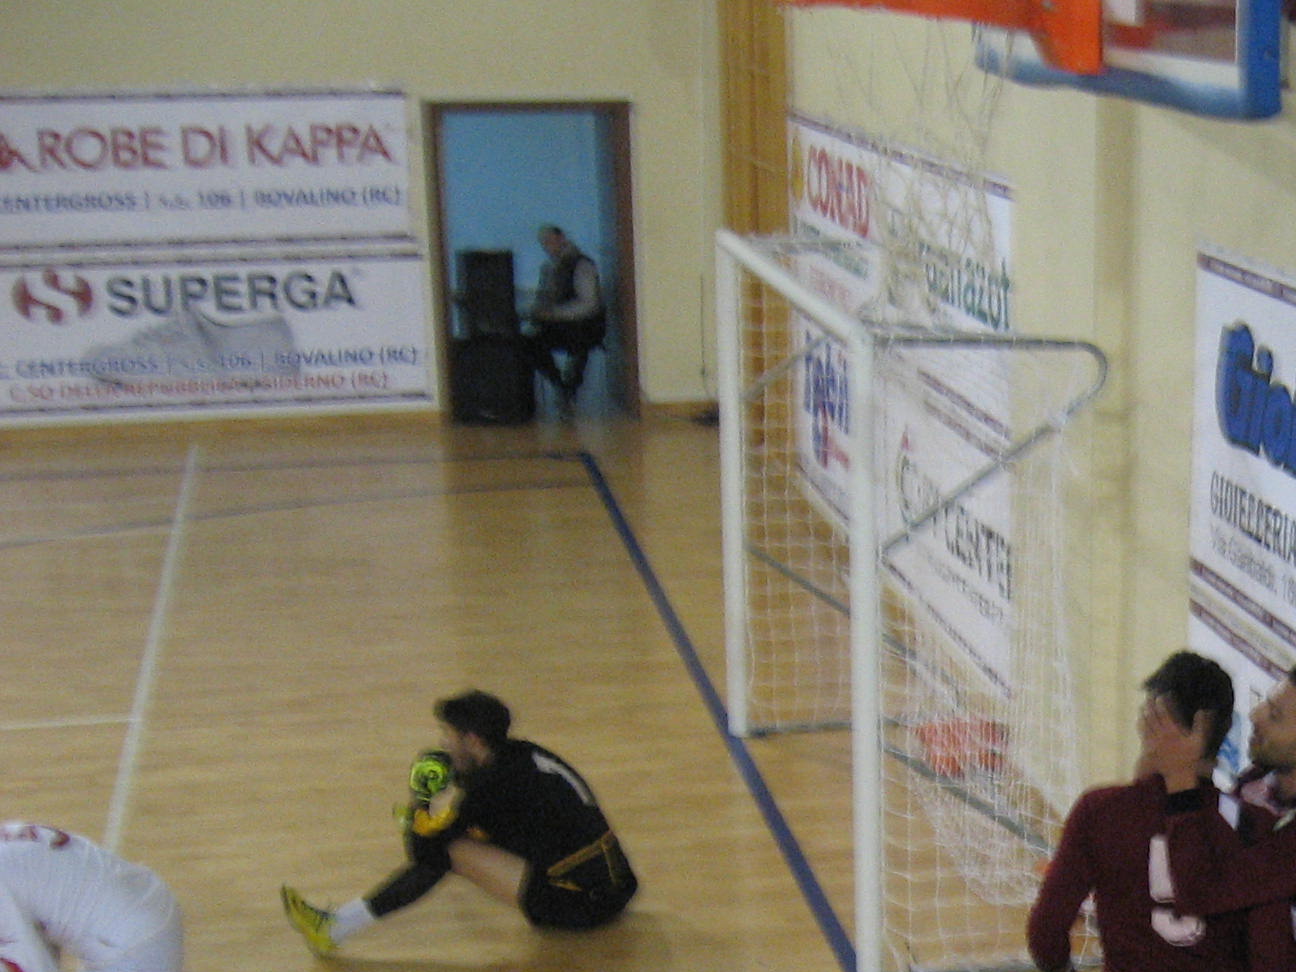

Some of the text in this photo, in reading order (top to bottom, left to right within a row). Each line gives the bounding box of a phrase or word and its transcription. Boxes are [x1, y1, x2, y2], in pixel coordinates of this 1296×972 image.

[37, 122, 394, 172] ROBE DI KAPPA
[255, 188, 357, 209] BOVALINO
[106, 270, 357, 318] SUPERGA
[274, 347, 375, 367] BOVALINO
